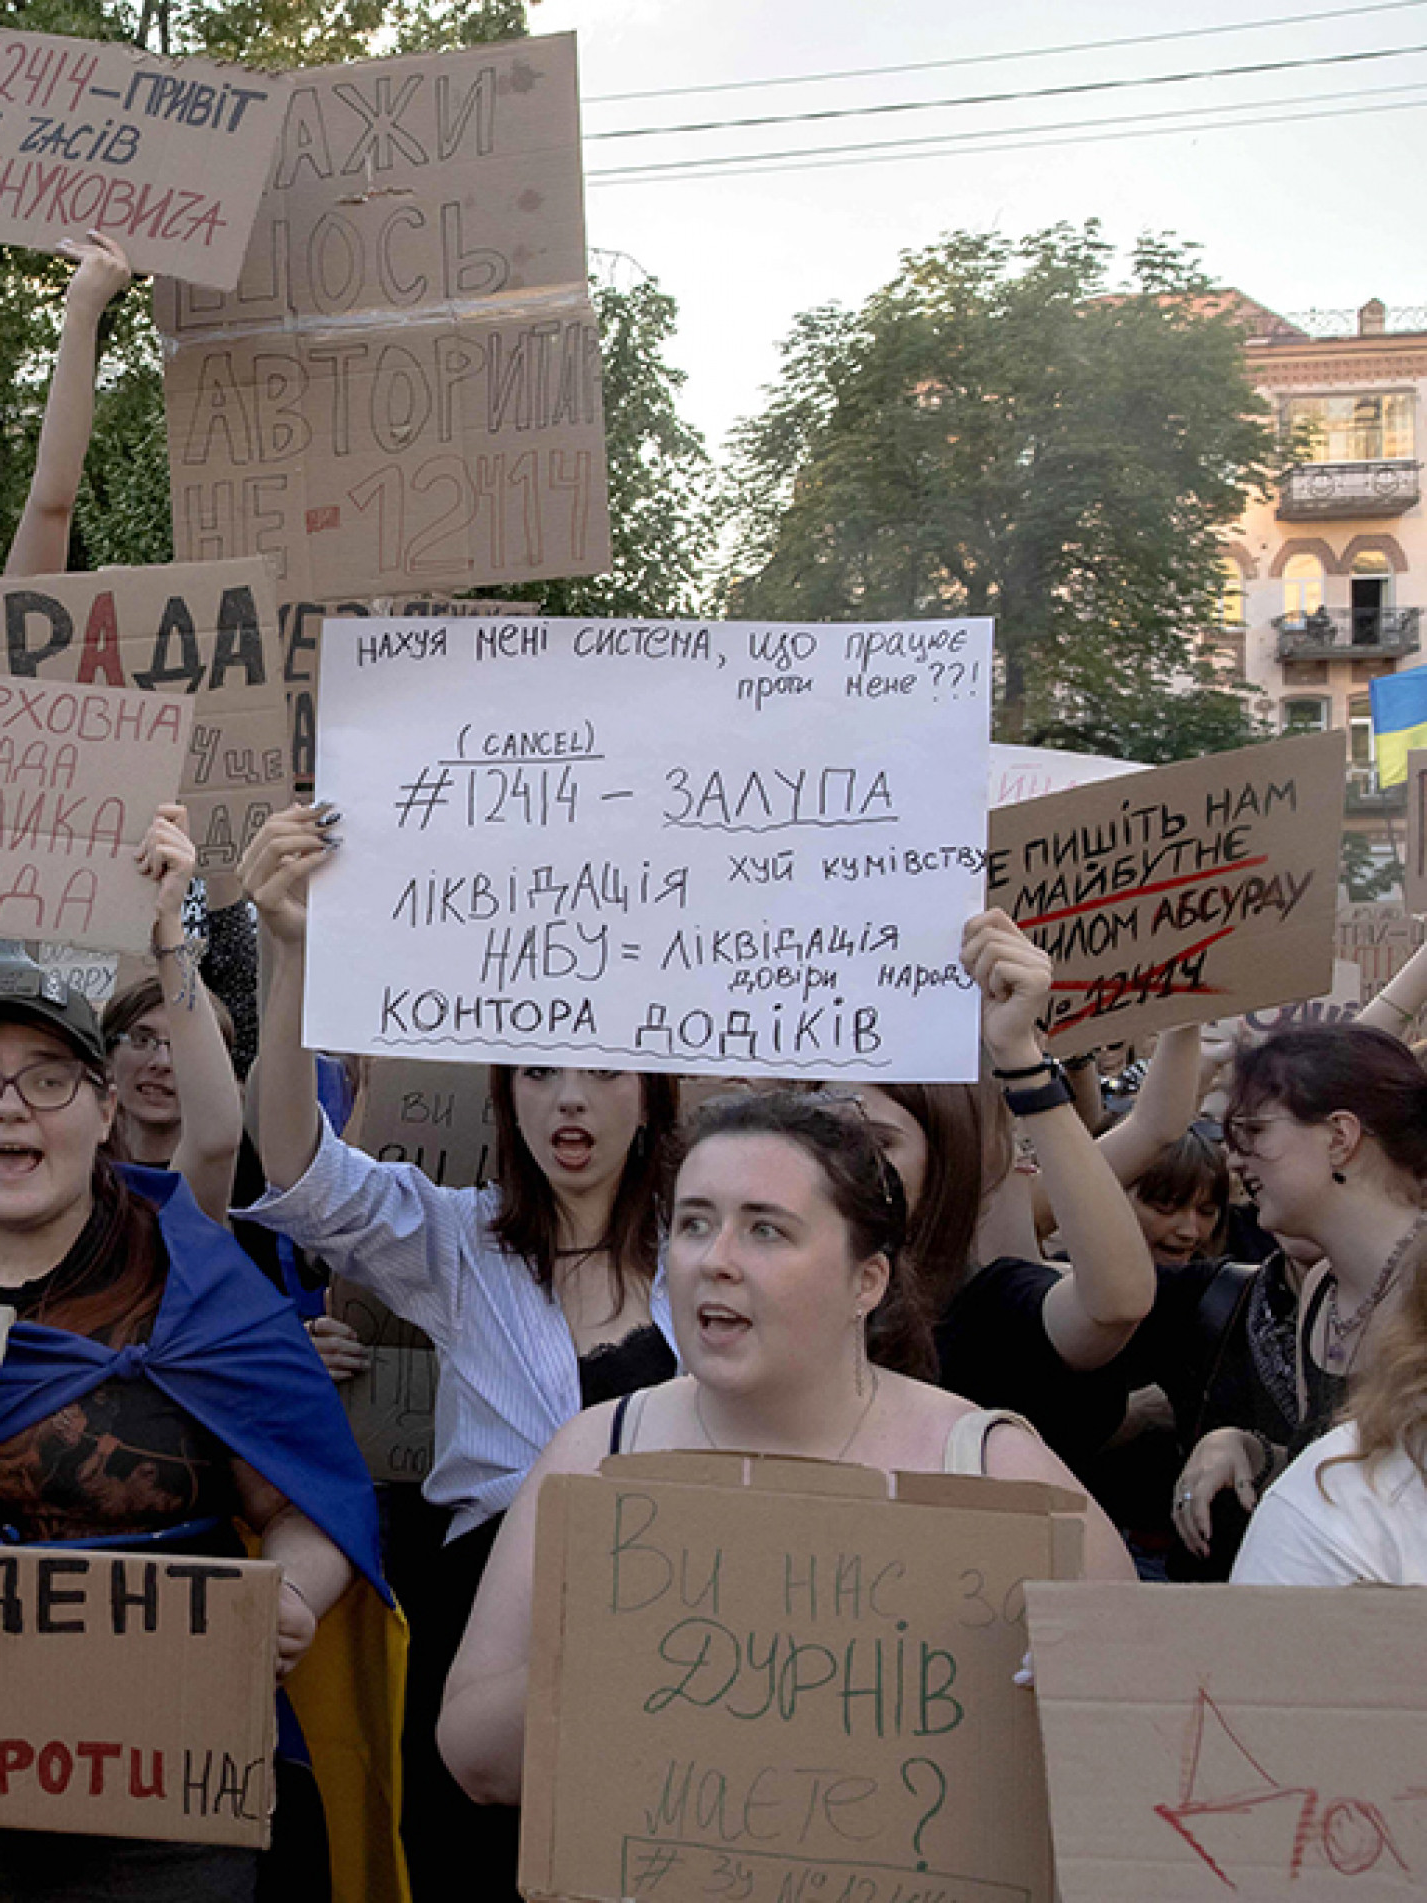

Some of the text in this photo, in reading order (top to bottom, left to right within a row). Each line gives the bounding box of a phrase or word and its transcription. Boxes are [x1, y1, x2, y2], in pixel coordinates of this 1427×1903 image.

[275, 66, 497, 190] АЖИ
[4, 585, 265, 693] РАДА
[357, 625, 448, 666] НАХУЯ
[394, 763, 579, 830] #12414
[663, 766, 894, 824] ЗАЛУПА
[988, 849, 1011, 890] Е
[1205, 779, 1297, 827] НАМ
[1151, 868, 1316, 936] АБСУРДУ
[480, 921, 609, 991] НАБУ
[1084, 951, 1209, 1018] 12414
[380, 988, 597, 1035] КОНТОРА
[643, 1616, 966, 1742] ДУРНІВ
[181, 1749, 273, 1824] НАС
